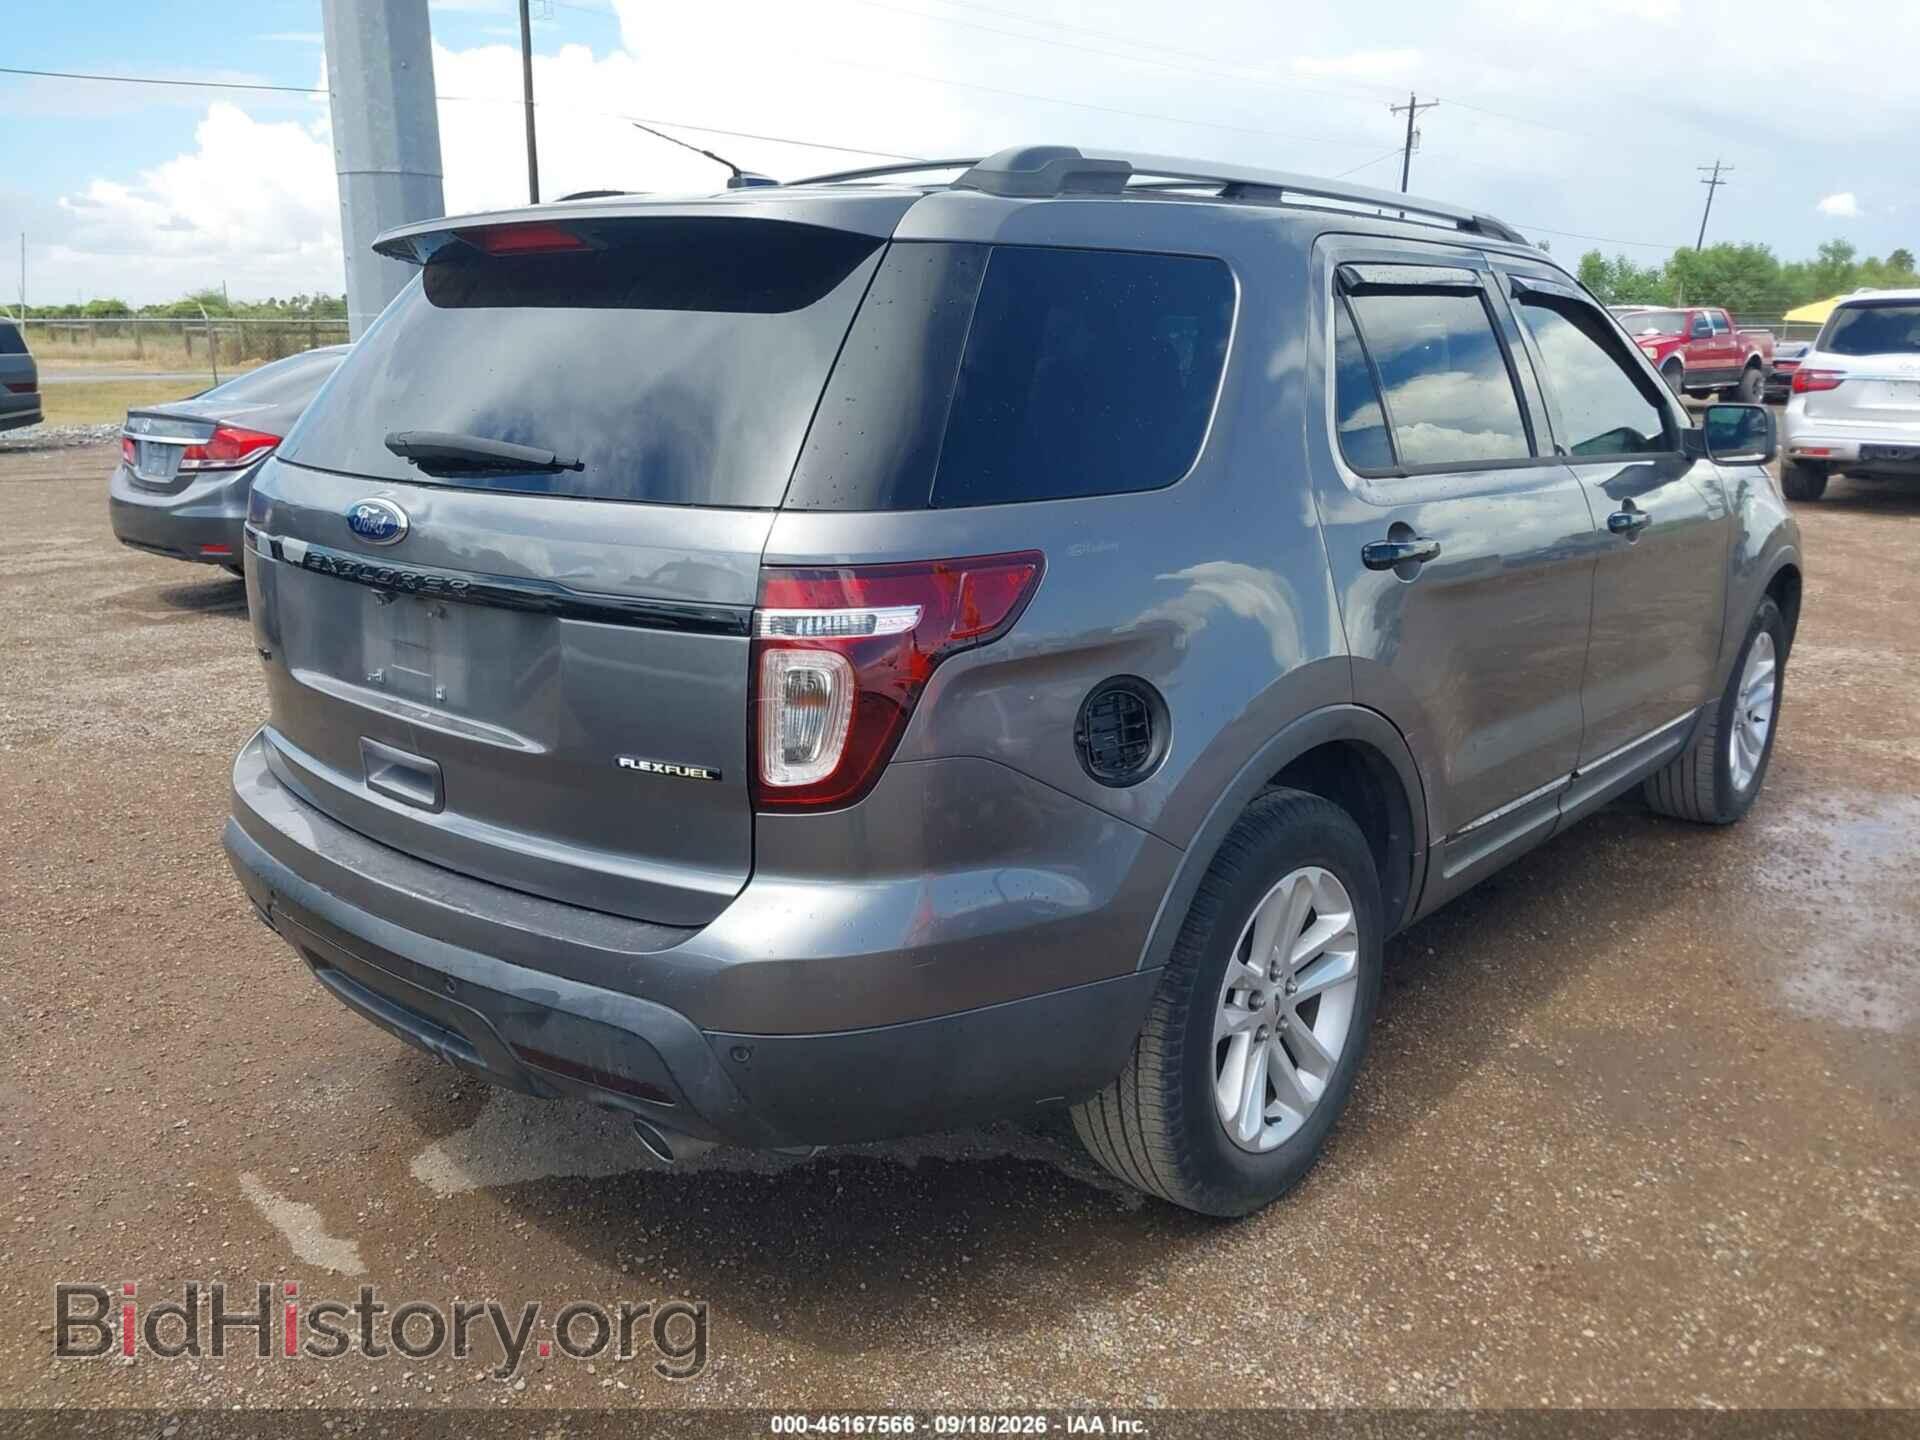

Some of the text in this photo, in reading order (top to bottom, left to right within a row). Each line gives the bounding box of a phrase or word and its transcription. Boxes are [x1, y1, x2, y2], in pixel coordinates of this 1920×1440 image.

[354, 505, 387, 536] Ford
[306, 552, 471, 597] EXPLORER
[619, 757, 713, 780] FLEXFUEL
